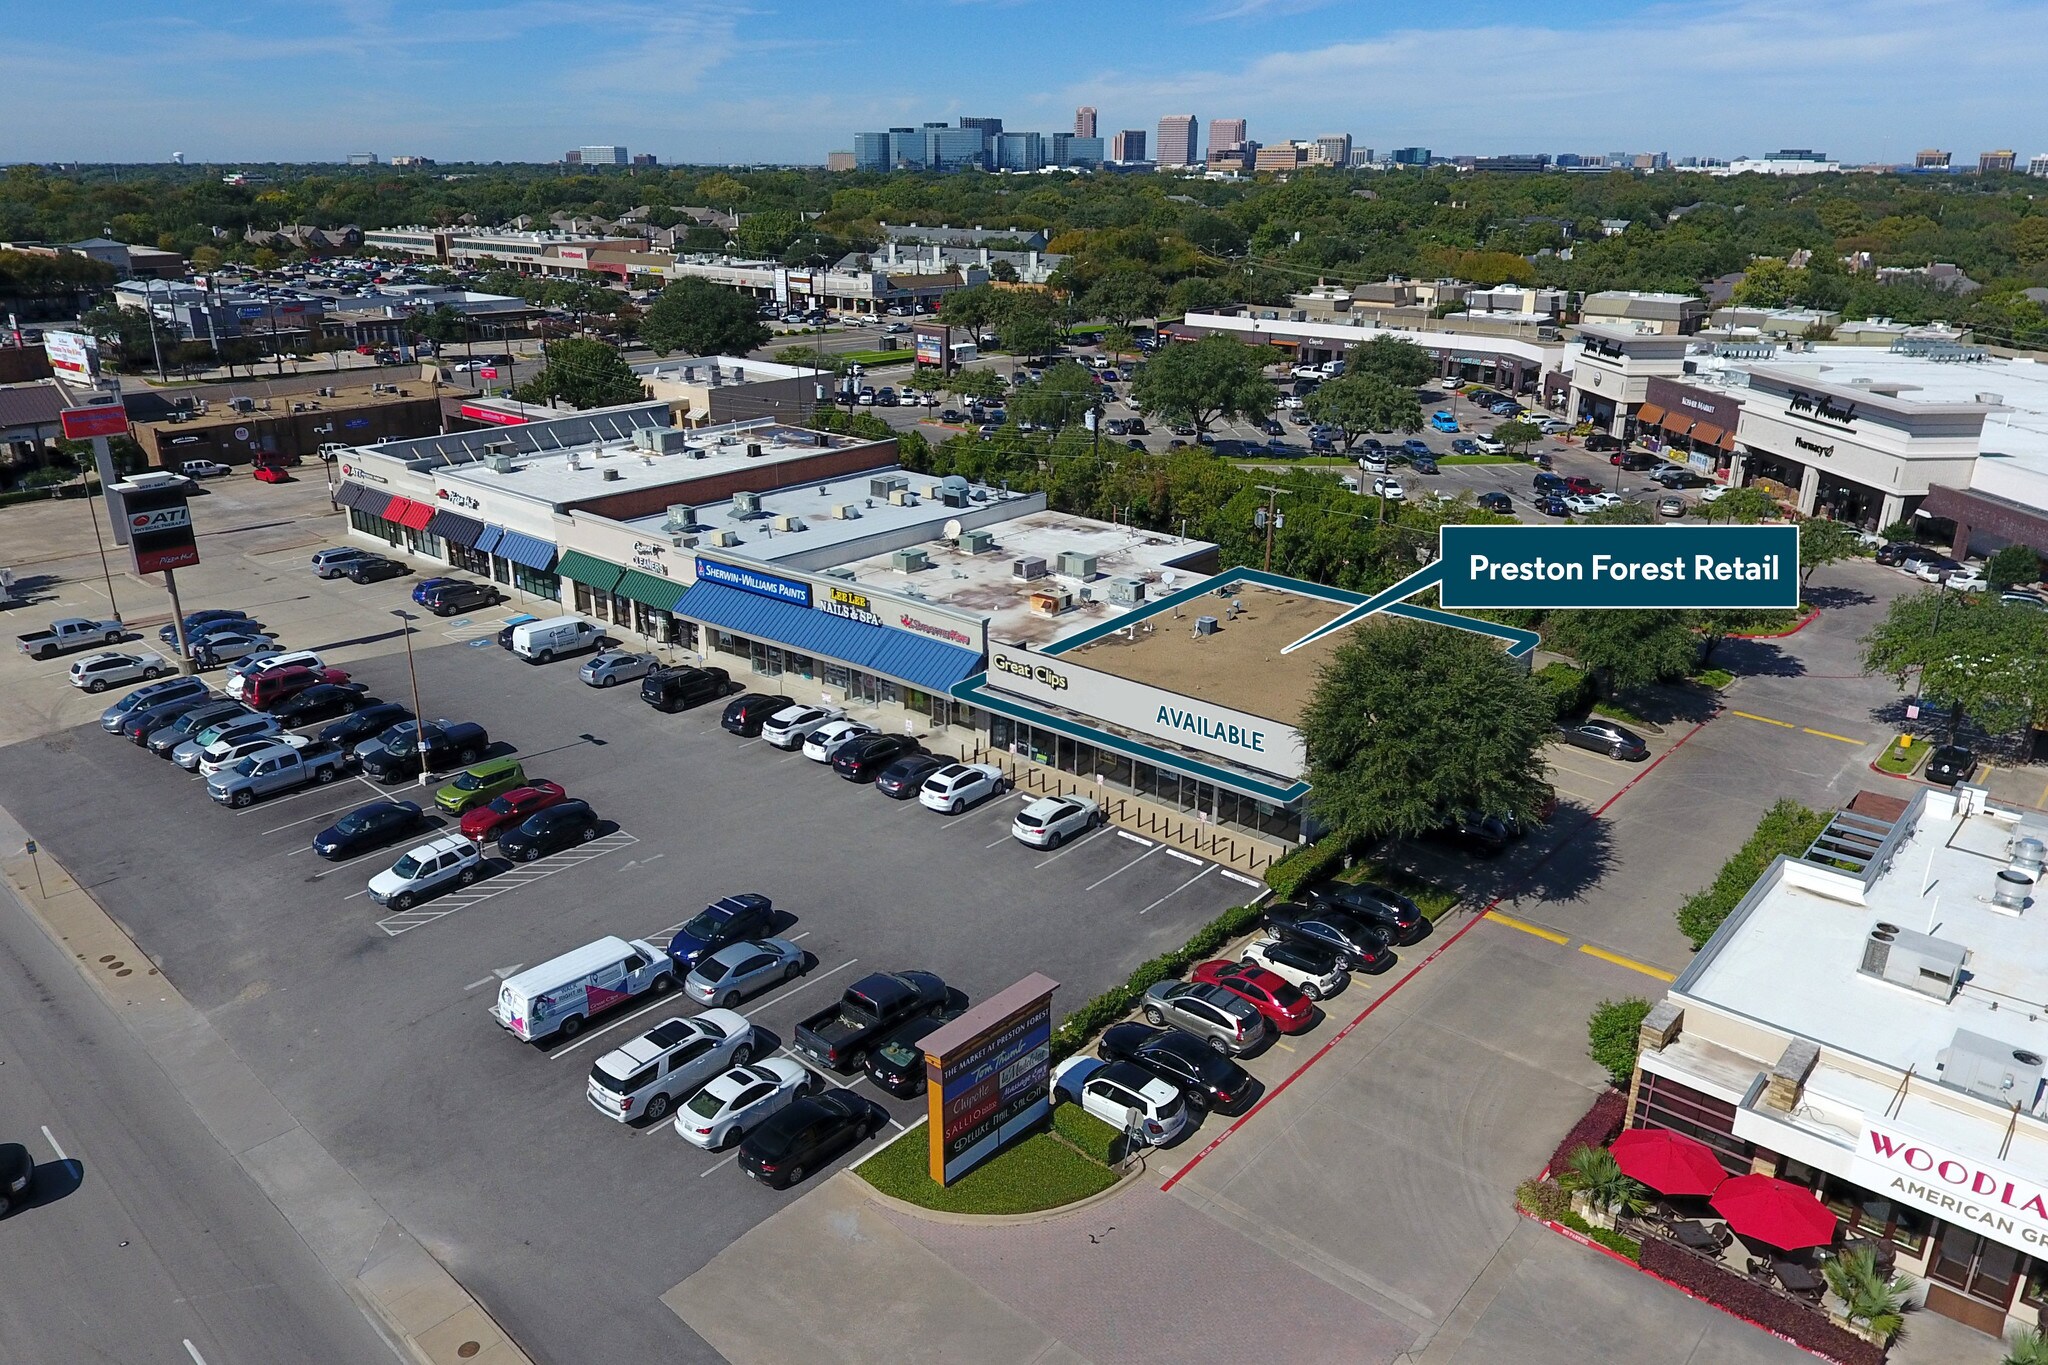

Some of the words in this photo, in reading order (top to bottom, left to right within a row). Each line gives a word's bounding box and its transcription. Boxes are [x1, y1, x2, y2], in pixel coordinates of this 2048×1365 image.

[1698, 401, 1716, 414] MARKET
[1795, 436, 1824, 457] Pharmacy
[134, 524, 160, 532] PHYSICAL
[161, 521, 186, 529] THERAPY
[151, 509, 186, 525] ATI
[632, 556, 668, 576] CLEANERS
[779, 583, 806, 600] PAINTS
[830, 588, 848, 603] LEE
[849, 592, 866, 607] LEE
[820, 601, 850, 619] NAILS
[859, 612, 879, 627] SPA
[994, 655, 1031, 678] Great
[1035, 666, 1066, 689] Clips
[559, 991, 576, 1000] RIGHT
[561, 983, 577, 994] WALK
[944, 1067, 957, 1079] THE
[958, 1048, 987, 1071] MARKET
[987, 1042, 997, 1053] AT
[997, 1024, 1026, 1046] PRESTON
[1026, 1009, 1050, 1028] FOREST
[971, 1063, 993, 1083] Tom
[992, 1041, 1027, 1069] Thumb
[1002, 1073, 1031, 1099] Massage
[1031, 1064, 1048, 1079] Envy
[953, 1084, 990, 1114] Chipotle
[1890, 1177, 2014, 1234] AMERICAN
